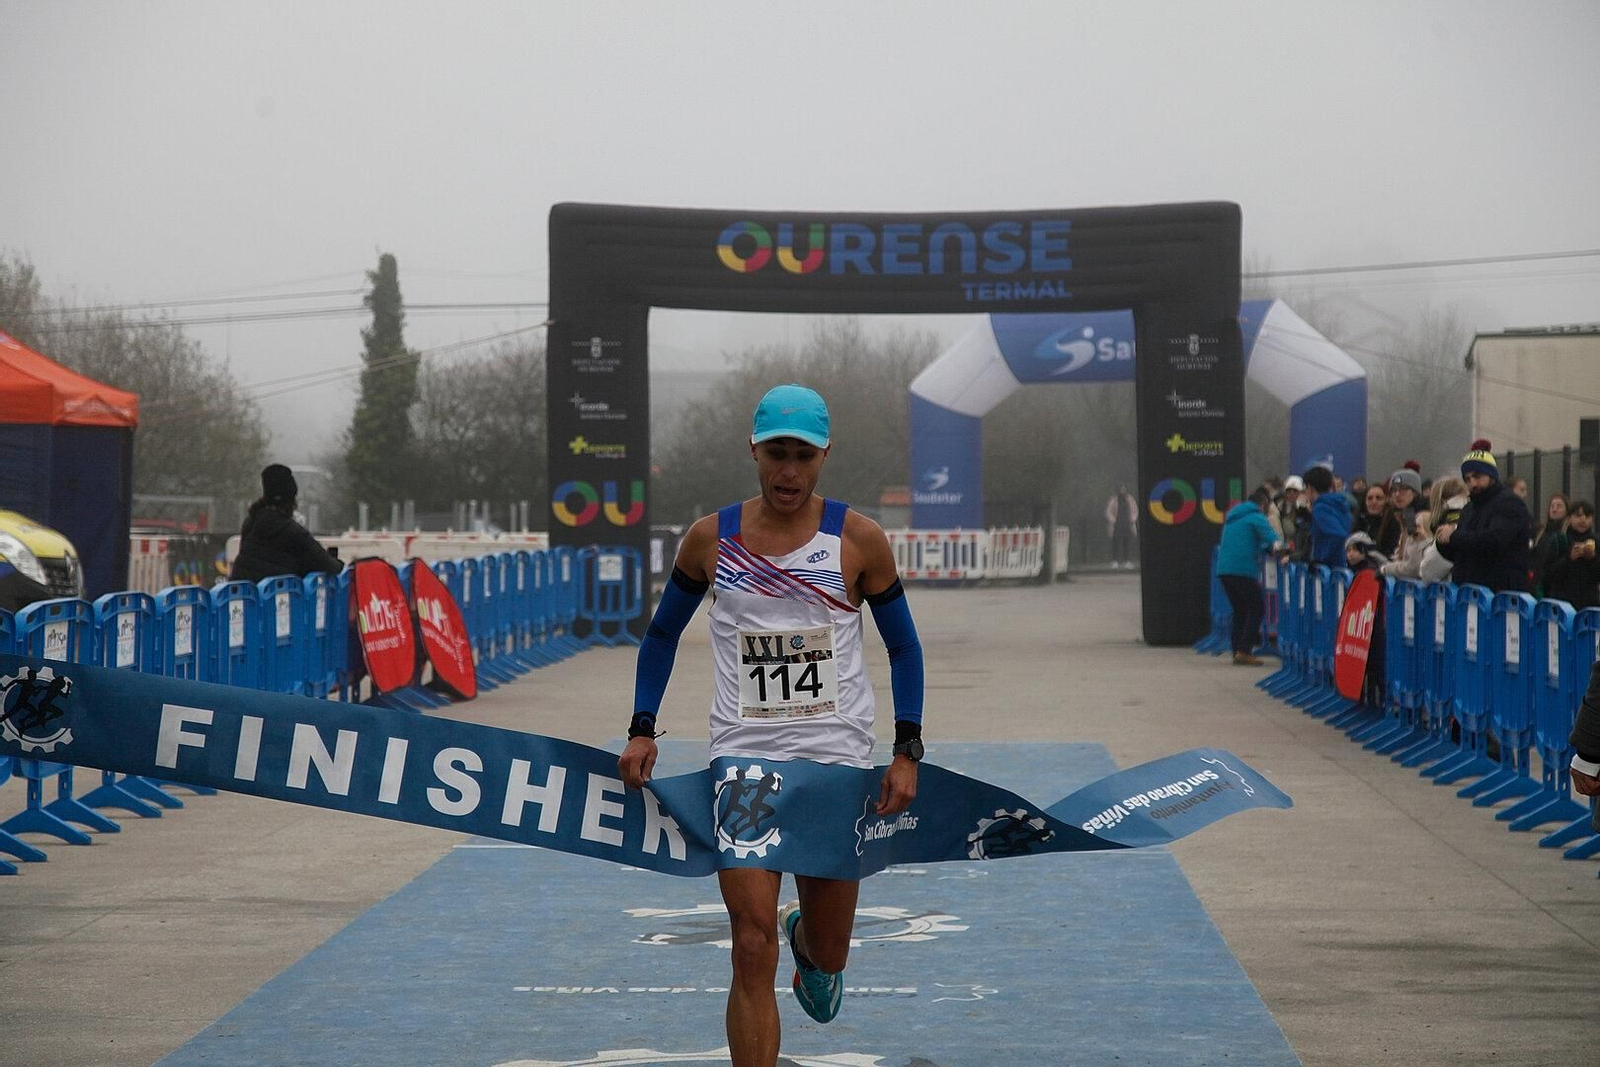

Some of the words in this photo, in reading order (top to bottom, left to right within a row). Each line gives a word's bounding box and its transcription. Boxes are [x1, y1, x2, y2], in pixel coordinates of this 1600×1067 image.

[717, 220, 1073, 275] OURENSE
[962, 279, 1073, 301] TERMAL
[1098, 337, 1136, 362] Sa
[551, 480, 646, 528] OU
[748, 662, 824, 702] 114
[154, 703, 687, 861] FINISHER
[1147, 780, 1194, 801] Cibrao
[1186, 769, 1220, 787] San
[1122, 794, 1151, 810] das
[1081, 804, 1131, 835] Viñas
